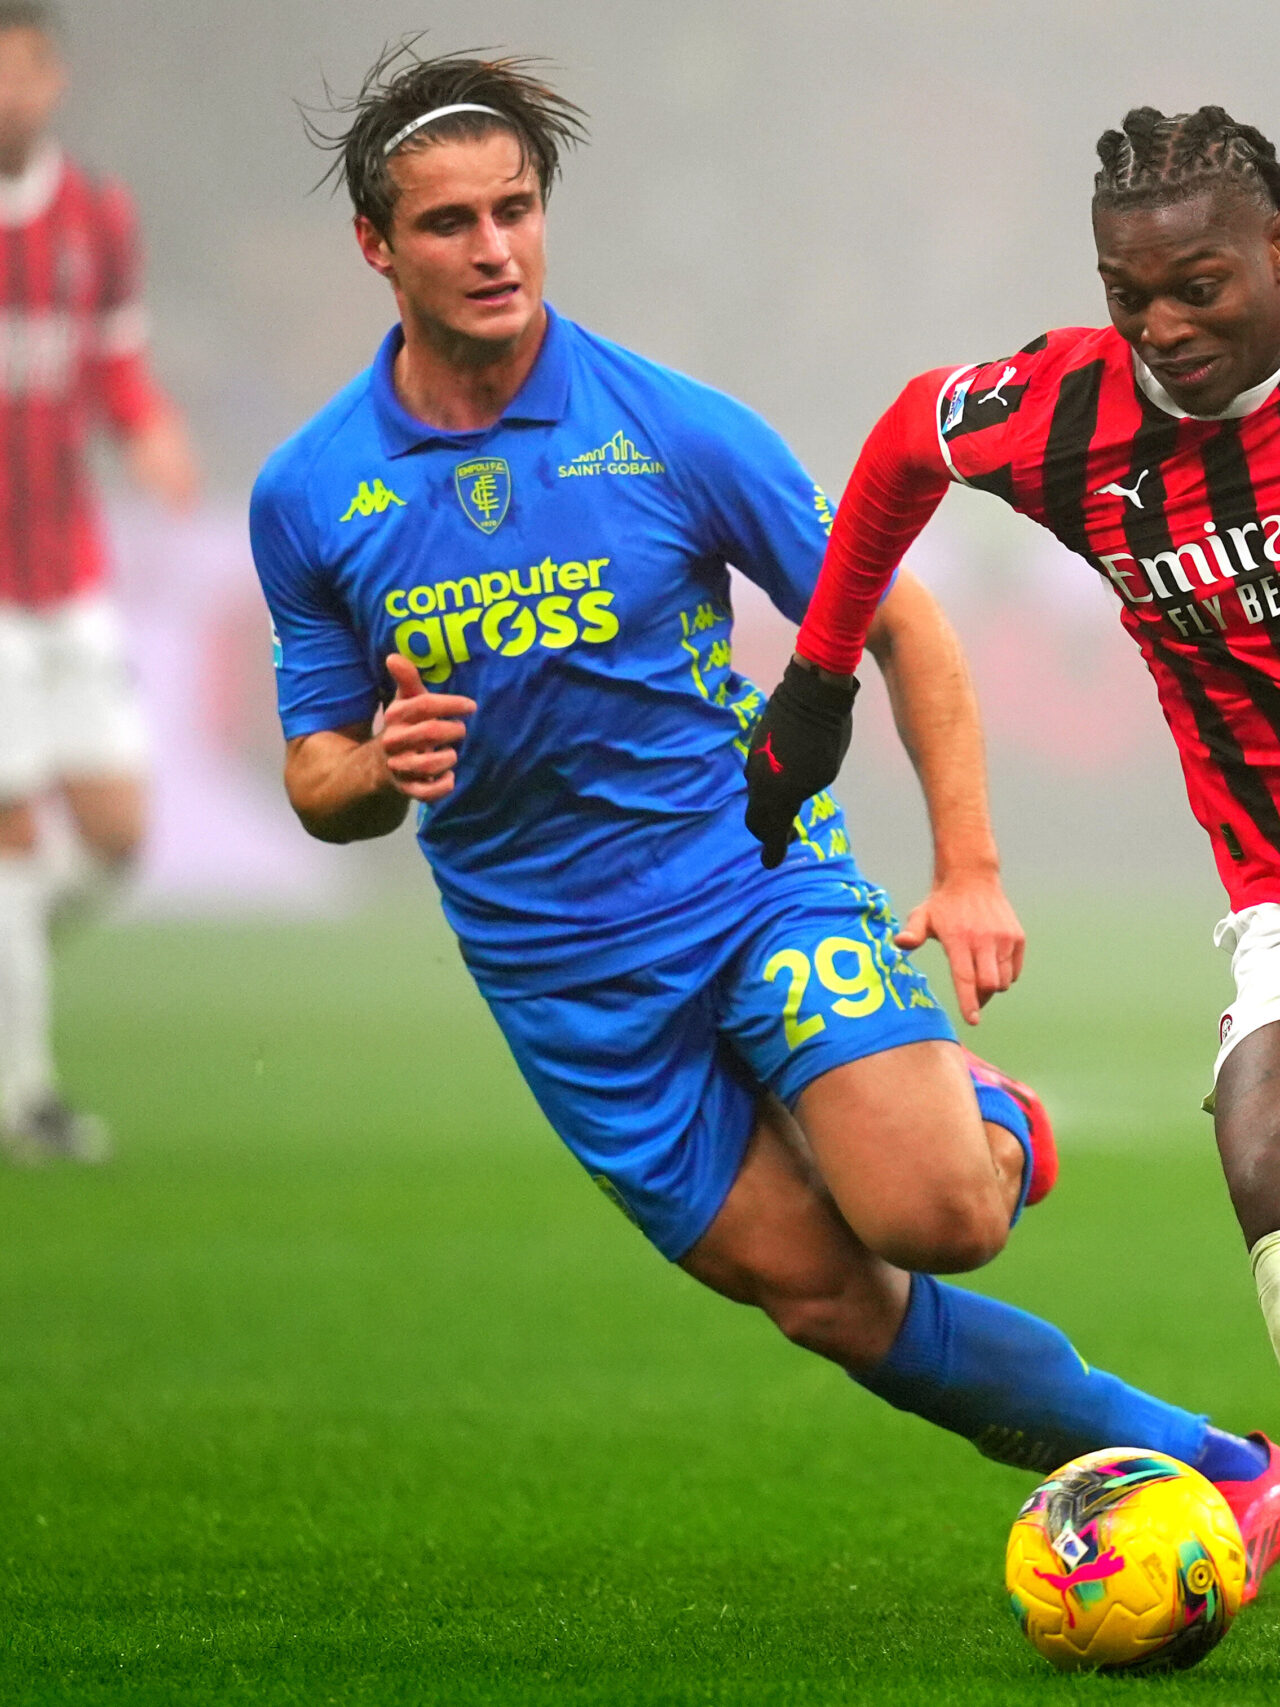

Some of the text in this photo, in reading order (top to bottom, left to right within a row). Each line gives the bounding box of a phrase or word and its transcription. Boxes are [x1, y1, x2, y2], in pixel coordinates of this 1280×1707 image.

[558, 461, 665, 478] SAINT-GOBAIN
[385, 556, 610, 618] computer
[1167, 594, 1228, 638] FLY
[394, 590, 620, 684] gross
[762, 936, 886, 1052] 29
